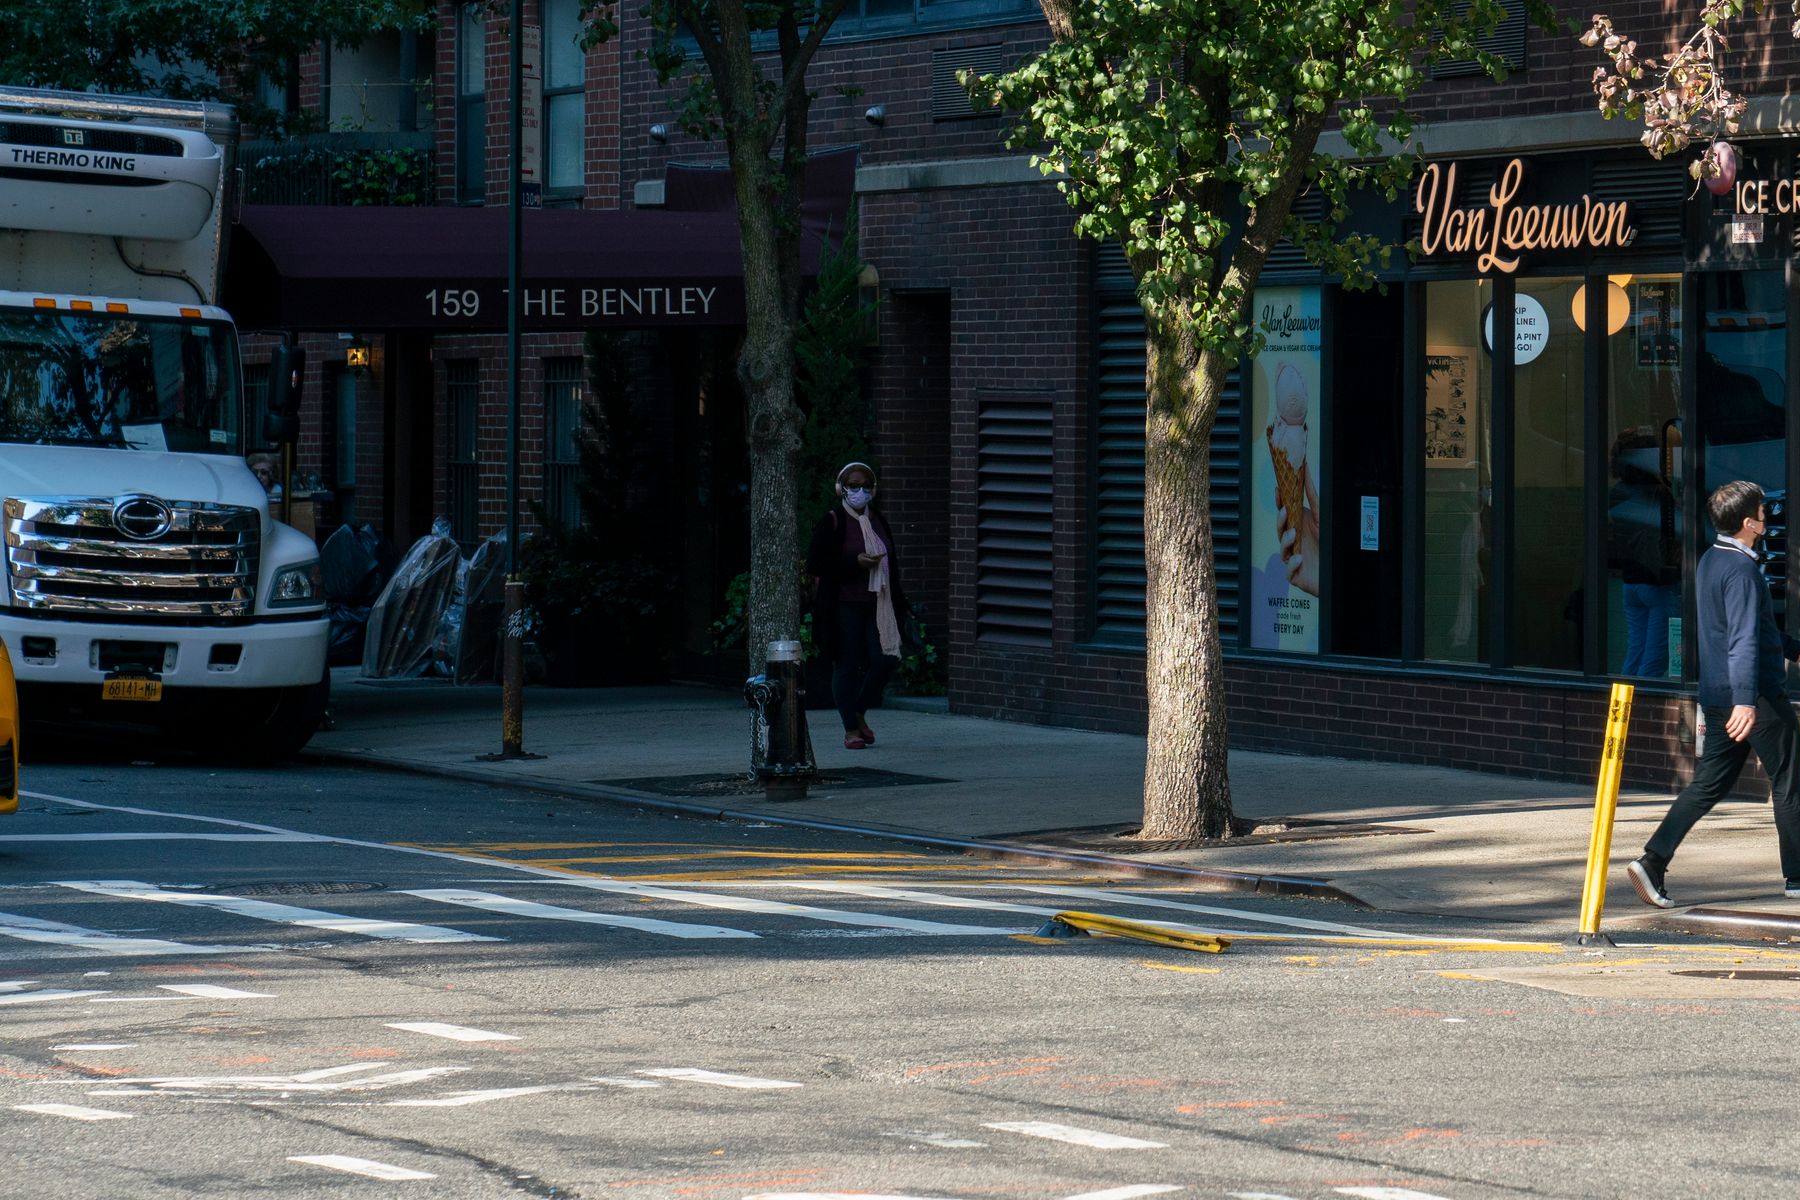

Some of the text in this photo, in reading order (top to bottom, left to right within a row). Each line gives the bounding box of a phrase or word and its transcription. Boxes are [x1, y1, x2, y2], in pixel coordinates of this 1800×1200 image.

[11, 148, 136, 171] THERMO KING
[1736, 180, 1768, 214] ICE
[1416, 158, 1631, 273] Van Leeuwen
[425, 289, 480, 317] 159
[581, 287, 717, 316] BENTLEY
[1514, 307, 1527, 315] KIP
[1262, 305, 1321, 338] Van Leeuwen
[1516, 318, 1536, 326] LINE!
[1524, 333, 1542, 341] PINT
[1268, 597, 1310, 609] WAFFLE CONES
[1273, 623, 1304, 635] EVERY DAY
